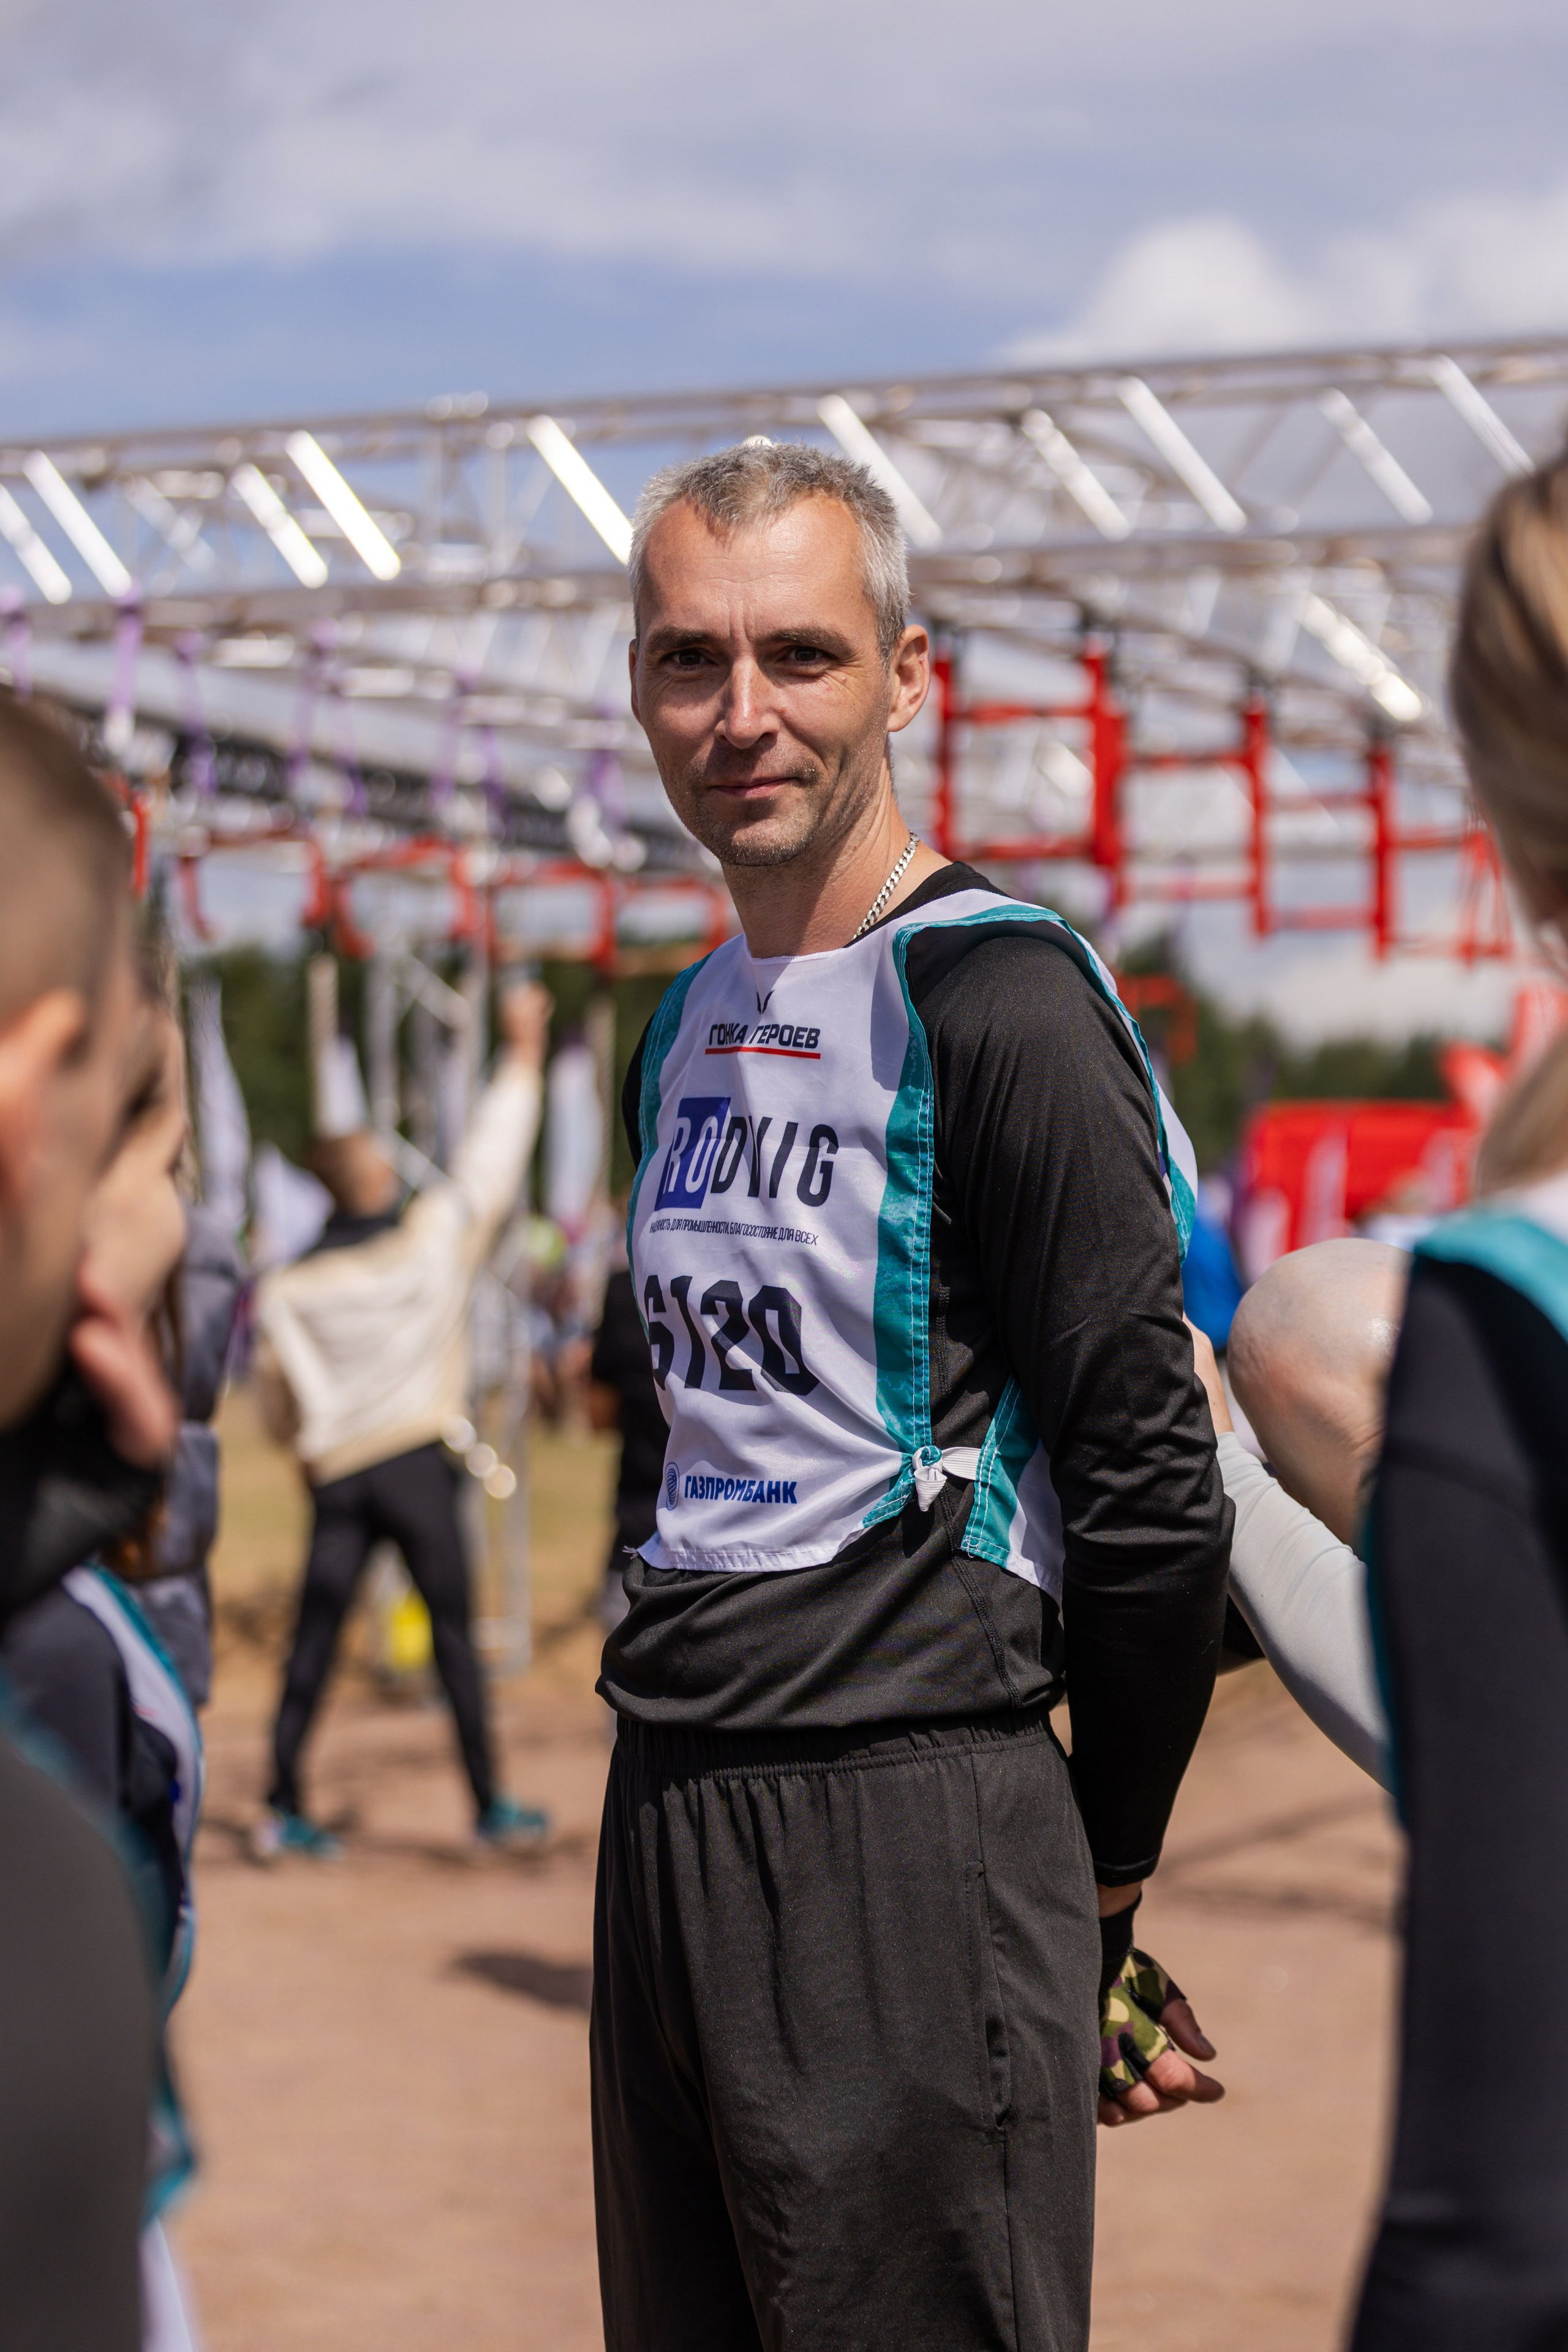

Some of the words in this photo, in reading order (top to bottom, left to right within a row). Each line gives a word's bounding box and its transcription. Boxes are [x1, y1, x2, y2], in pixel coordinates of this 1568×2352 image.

[709, 1022, 748, 1045] ГОНКА
[748, 1023, 821, 1049] ГЕРОЕВ
[663, 1115, 839, 1207] RODVIG
[669, 1218, 683, 1231] ДЛЯ
[729, 1222, 778, 1239] БЛАГОСОСТОЯНИЕ
[778, 1227, 794, 1242] ДЛЯ
[794, 1230, 819, 1245] ВСЕХ
[644, 1275, 820, 1396] 6120
[684, 1475, 797, 1504] ГАЗПРОМБАНК
